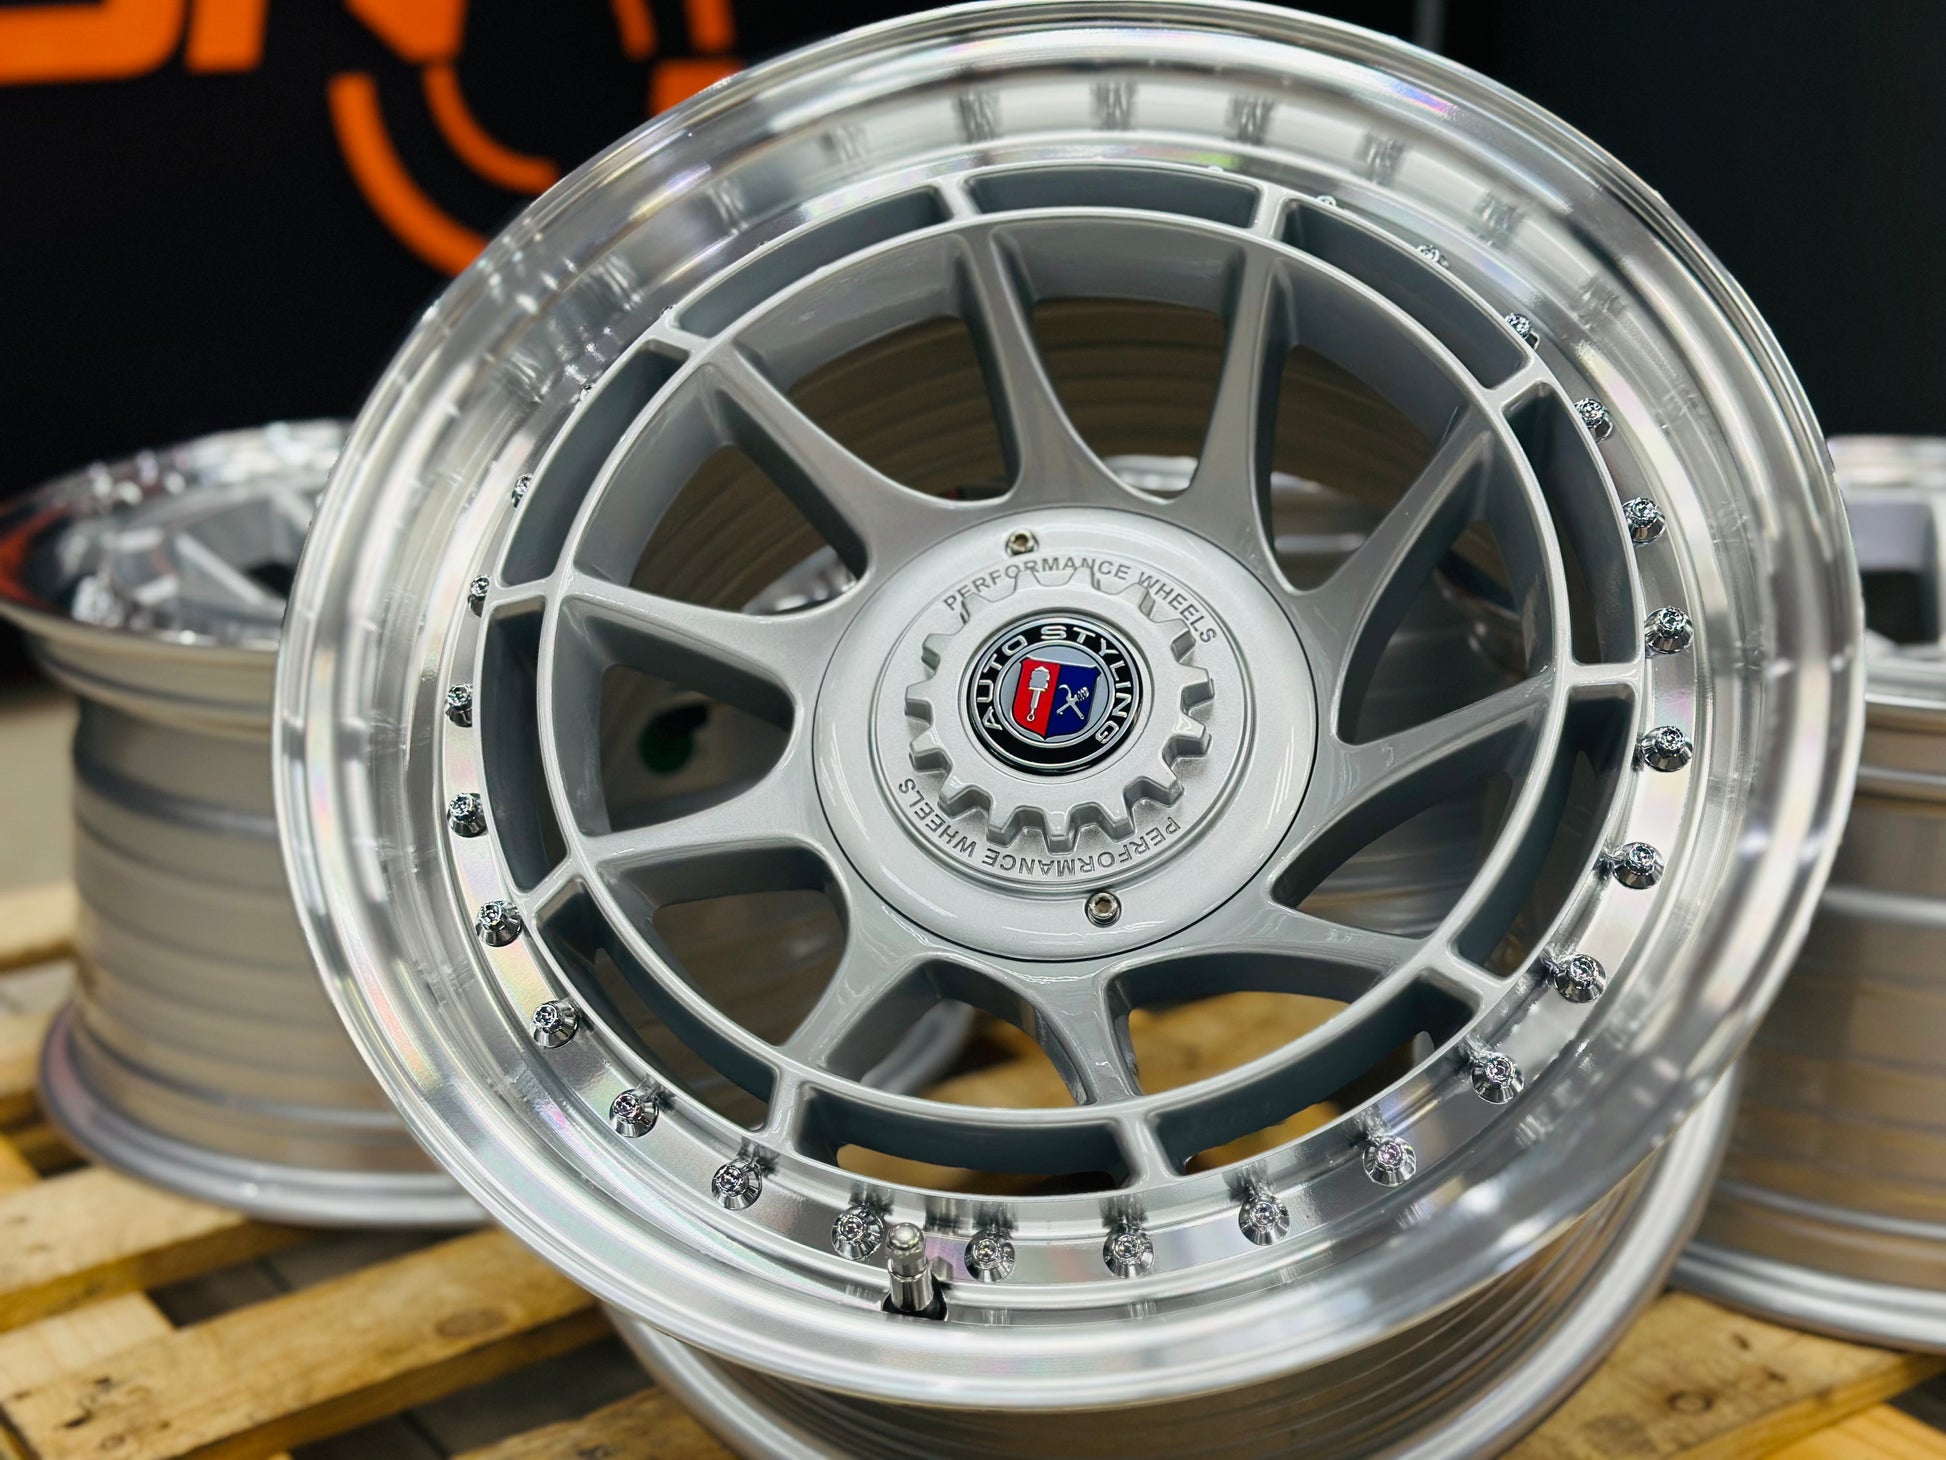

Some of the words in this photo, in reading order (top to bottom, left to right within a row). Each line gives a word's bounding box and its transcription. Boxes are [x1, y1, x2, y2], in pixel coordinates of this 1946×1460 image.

[943, 557, 1131, 611] PERFORMANCE
[1137, 571, 1217, 644] WHEELS
[976, 635, 1029, 731] AUTO
[1040, 624, 1133, 744] STYLING
[898, 778, 977, 857] WHEELS
[986, 816, 1181, 877] PERFORMANCE
